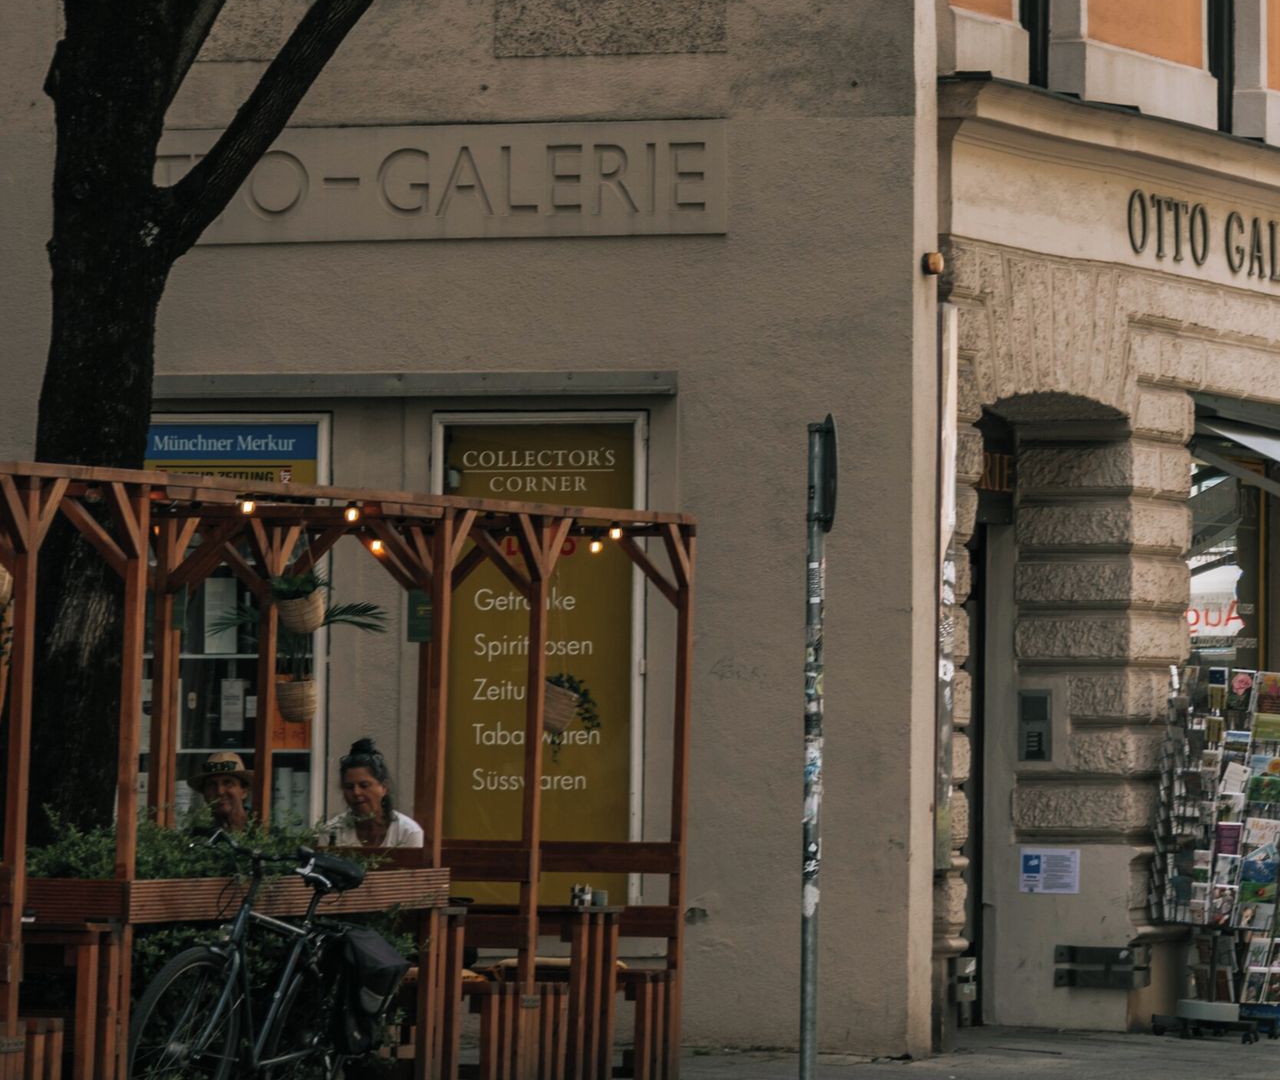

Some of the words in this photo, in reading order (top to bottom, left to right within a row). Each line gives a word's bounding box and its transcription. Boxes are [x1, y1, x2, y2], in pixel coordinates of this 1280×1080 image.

[1127, 188, 1209, 266] OTTO
[153, 434, 234, 452] Münchner
[237, 434, 296, 452] Merkur
[489, 476, 588, 492] CORNER
[474, 586, 576, 611] Getrke
[473, 633, 593, 662] Spiritosen
